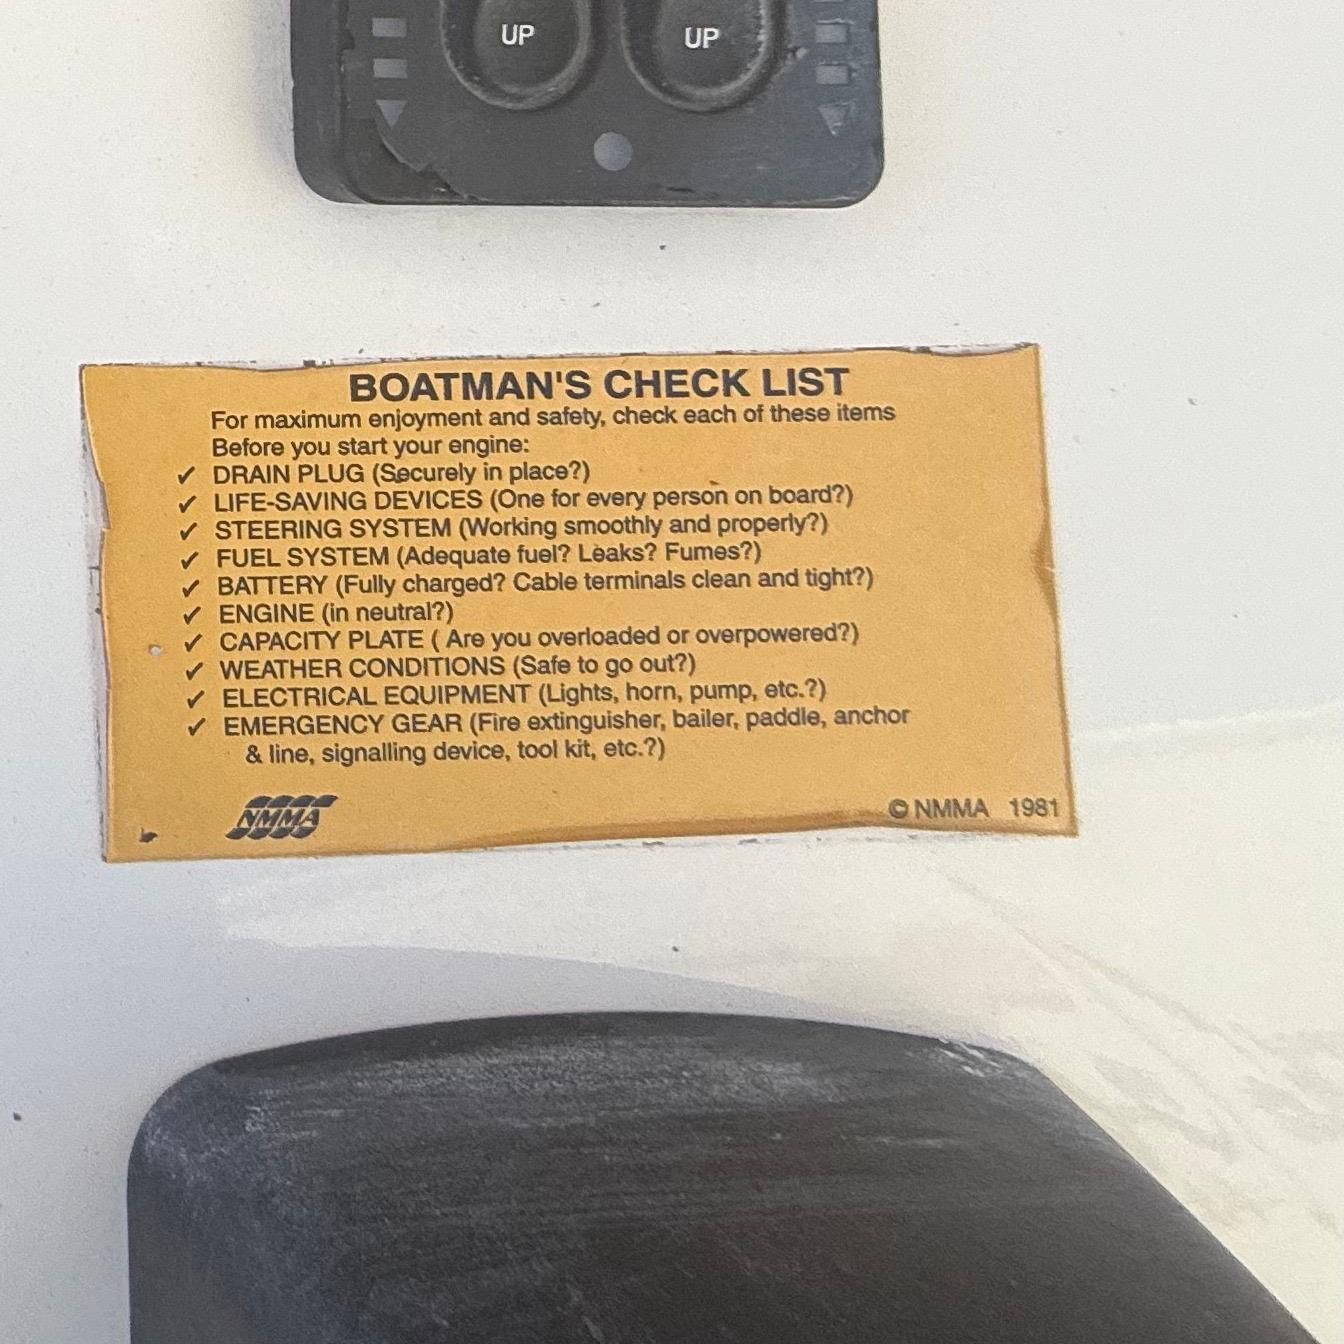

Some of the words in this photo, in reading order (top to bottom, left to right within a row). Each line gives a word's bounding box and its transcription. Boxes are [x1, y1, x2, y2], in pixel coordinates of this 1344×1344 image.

[501, 24, 535, 46] UP
[684, 26, 719, 50] UP
[349, 369, 593, 403] BOATMAN'S
[603, 367, 752, 400] CHECK
[761, 366, 851, 397] LIST
[211, 410, 249, 431] For
[254, 409, 363, 430] maximum
[368, 407, 484, 433] enjoyment
[488, 406, 531, 427] and
[536, 405, 607, 431] safety,
[611, 404, 679, 425] check
[682, 403, 738, 425] each
[742, 403, 765, 424] of
[768, 403, 832, 423] these
[836, 402, 897, 422] items
[212, 437, 286, 458] Before
[290, 440, 331, 462] you
[336, 436, 389, 457] start
[392, 438, 444, 461] your
[447, 434, 531, 459] engine:
[212, 463, 291, 485] DRAIN
[297, 463, 366, 484] PLUG
[372, 461, 478, 488] (Securely
[482, 461, 503, 482] in
[508, 459, 591, 486] place?)
[214, 490, 368, 513] LIFE-SAVING
[373, 488, 484, 511] DEVICES
[489, 488, 546, 514] (One
[550, 487, 582, 508] for
[585, 490, 649, 512] every
[652, 489, 730, 512] person
[734, 489, 763, 505] on
[768, 483, 854, 509] board?)
[214, 518, 343, 541] STEERING
[349, 516, 452, 539] SYSTEM
[458, 516, 558, 543] (Working
[563, 514, 664, 539] smoothly
[668, 512, 712, 535] and
[717, 511, 830, 539] properly?)
[216, 547, 282, 569] FUEL
[286, 545, 390, 568] SYSTEM
[396, 545, 512, 571] (Adequate
[516, 543, 572, 565] fuel?
[578, 541, 658, 564] Leaks?
[664, 540, 763, 565] Fumes?)
[217, 574, 329, 597] BATTERY
[335, 573, 397, 600] (Fully
[401, 571, 507, 599] charged?
[512, 571, 579, 593] Cable
[583, 569, 687, 592] terminals
[691, 568, 752, 590] clean
[757, 567, 800, 588] and
[804, 565, 874, 592] tight?)
[219, 602, 316, 625] ENGINE
[321, 601, 350, 628] (in
[355, 600, 454, 626] neutral?)
[219, 630, 342, 653] CAPACITY
[347, 629, 425, 651] PLATE
[445, 628, 486, 649] Are
[490, 631, 532, 653] you
[537, 624, 661, 648] overloaded
[666, 628, 691, 646] or
[694, 621, 860, 649] overpowered?)
[219, 657, 343, 681] WEATHER
[348, 655, 507, 679] CONDITIONS
[512, 654, 572, 681] (Safe
[576, 655, 600, 675] to
[604, 657, 634, 679] go
[639, 652, 697, 678] out?)
[222, 685, 379, 709] ELECTRICAL
[383, 683, 533, 706] EQUIPMENT
[538, 682, 620, 708] (Lights,
[625, 681, 684, 704] horn,
[689, 683, 759, 705] pump,
[763, 677, 827, 703] etc.?)
[223, 713, 385, 737] EMERGENCY
[390, 712, 464, 734] GEAR
[469, 711, 522, 738] (Fire
[526, 709, 667, 736] extinguisher,
[671, 707, 740, 731] bailer,
[745, 706, 827, 733] paddle,
[833, 704, 912, 726] anchor
[245, 743, 264, 765] &
[268, 743, 316, 766] line,
[321, 741, 427, 768] signalling
[432, 740, 511, 763] device,
[516, 738, 559, 761] tool
[564, 738, 597, 761] kit,
[603, 736, 666, 762] etc.?)
[914, 797, 990, 819] NMMA
[1009, 796, 1060, 818] 1981
